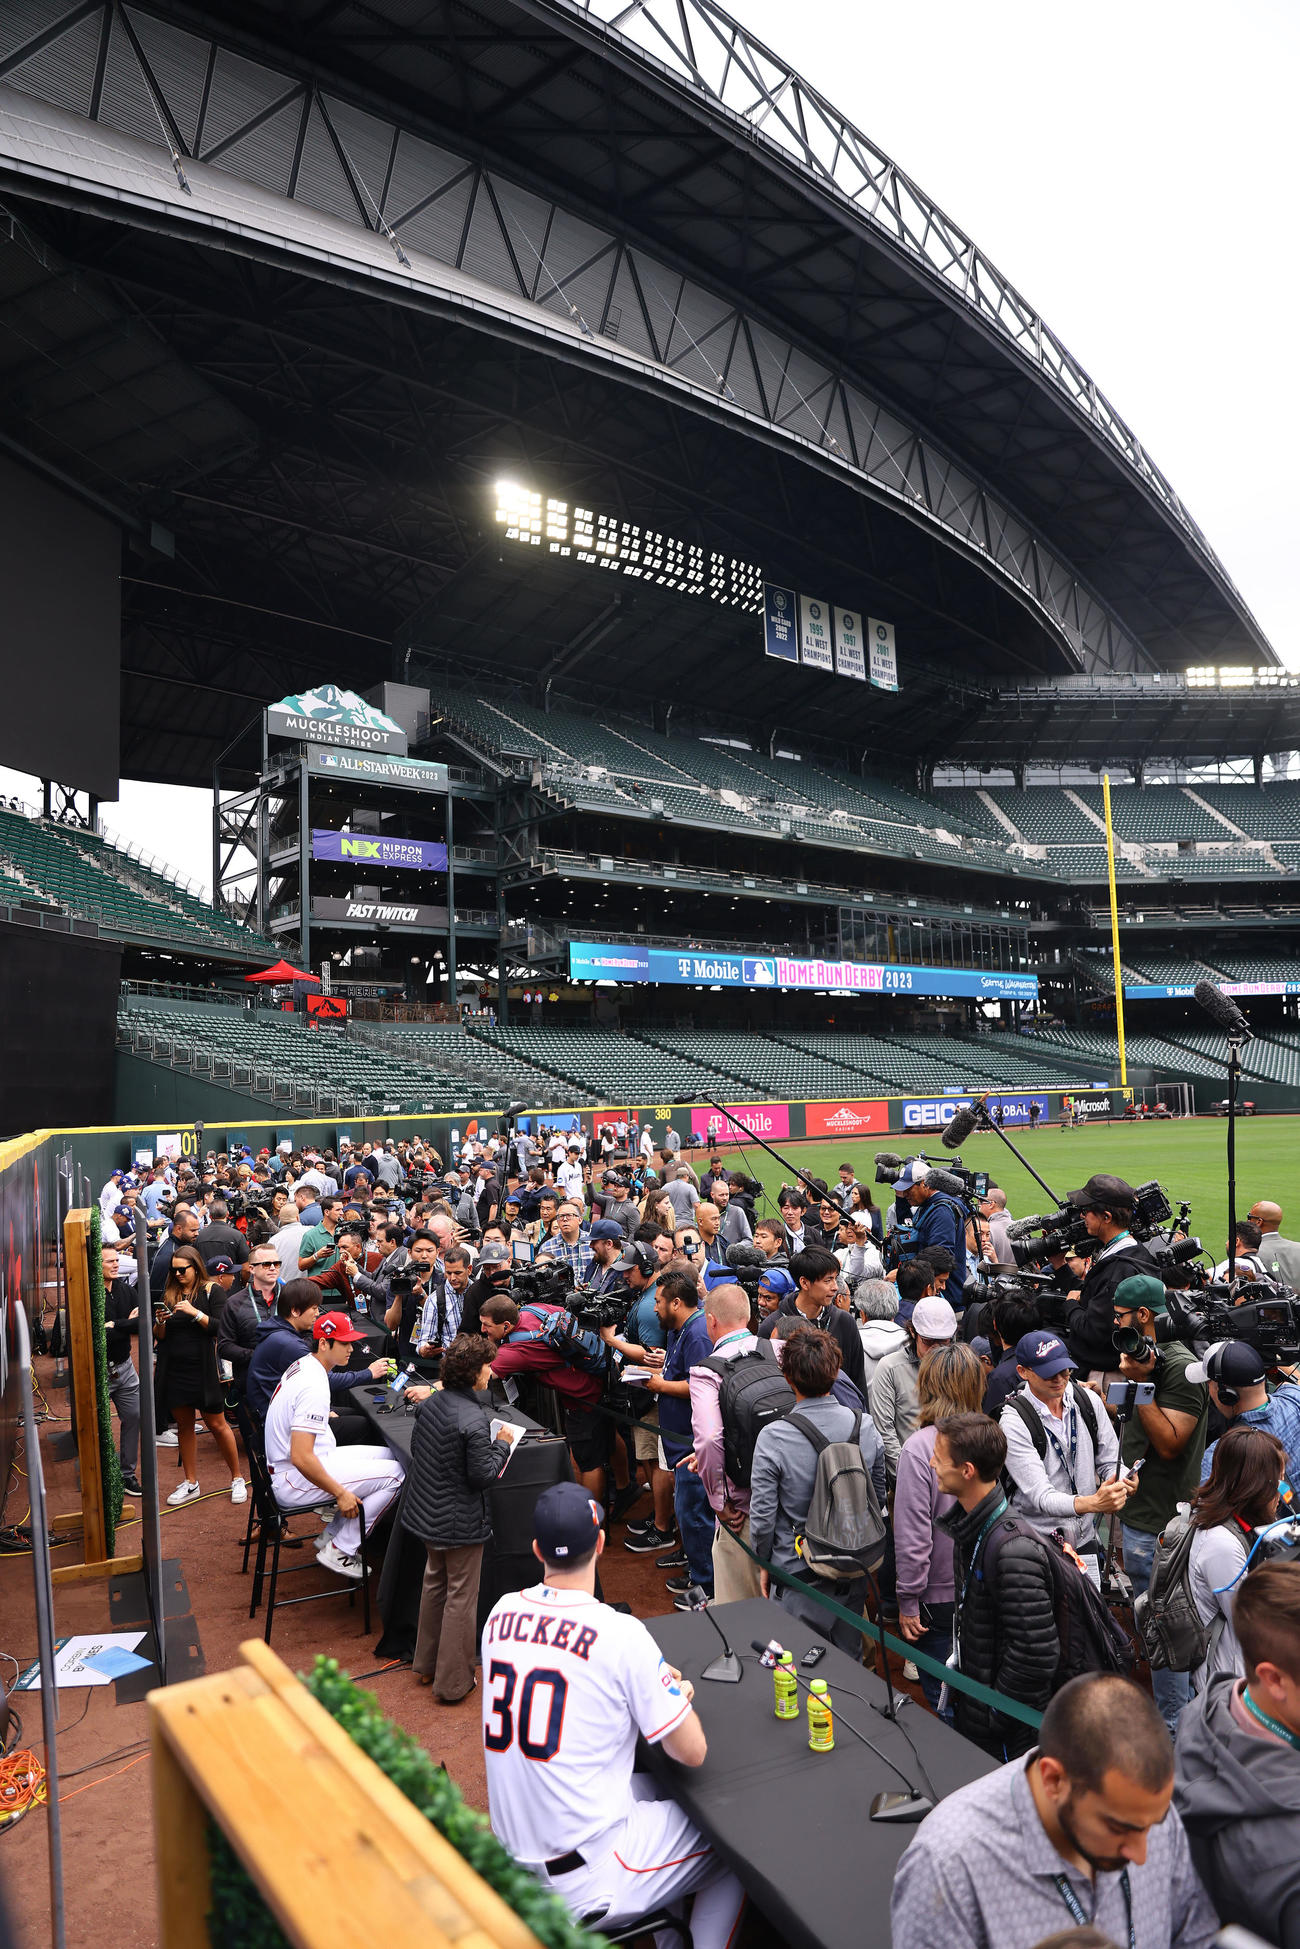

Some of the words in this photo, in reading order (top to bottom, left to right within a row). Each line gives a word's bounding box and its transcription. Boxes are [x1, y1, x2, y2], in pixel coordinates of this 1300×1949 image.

[809, 623, 823, 636] 1995
[815, 638, 828, 651] WEST
[804, 648, 831, 664] CHAMPIONS
[848, 648, 860, 661] WEST
[838, 658, 864, 674] CHAMPIONS
[880, 658, 893, 670] WEST
[872, 667, 897, 683] CHAMPIONS
[286, 717, 390, 744] MUCKLESHOOT
[305, 732, 341, 743] INDIAN
[344, 738, 373, 748] TRIBE
[421, 770, 439, 781] 2023
[382, 843, 423, 855] NIPPON
[382, 852, 423, 863] EXPRESS
[346, 904, 376, 918] FAST
[376, 906, 419, 921] TWITCH
[694, 960, 740, 980] Mobile
[886, 971, 913, 989] 2023
[1174, 986, 1195, 996] Mobil
[991, 1104, 1028, 1117] GOBAL
[655, 1109, 672, 1120] 380
[726, 1112, 772, 1134] Mobile
[177, 1132, 198, 1156] 01
[488, 1610, 598, 1662] TUCKER
[485, 1658, 568, 1763] 30
